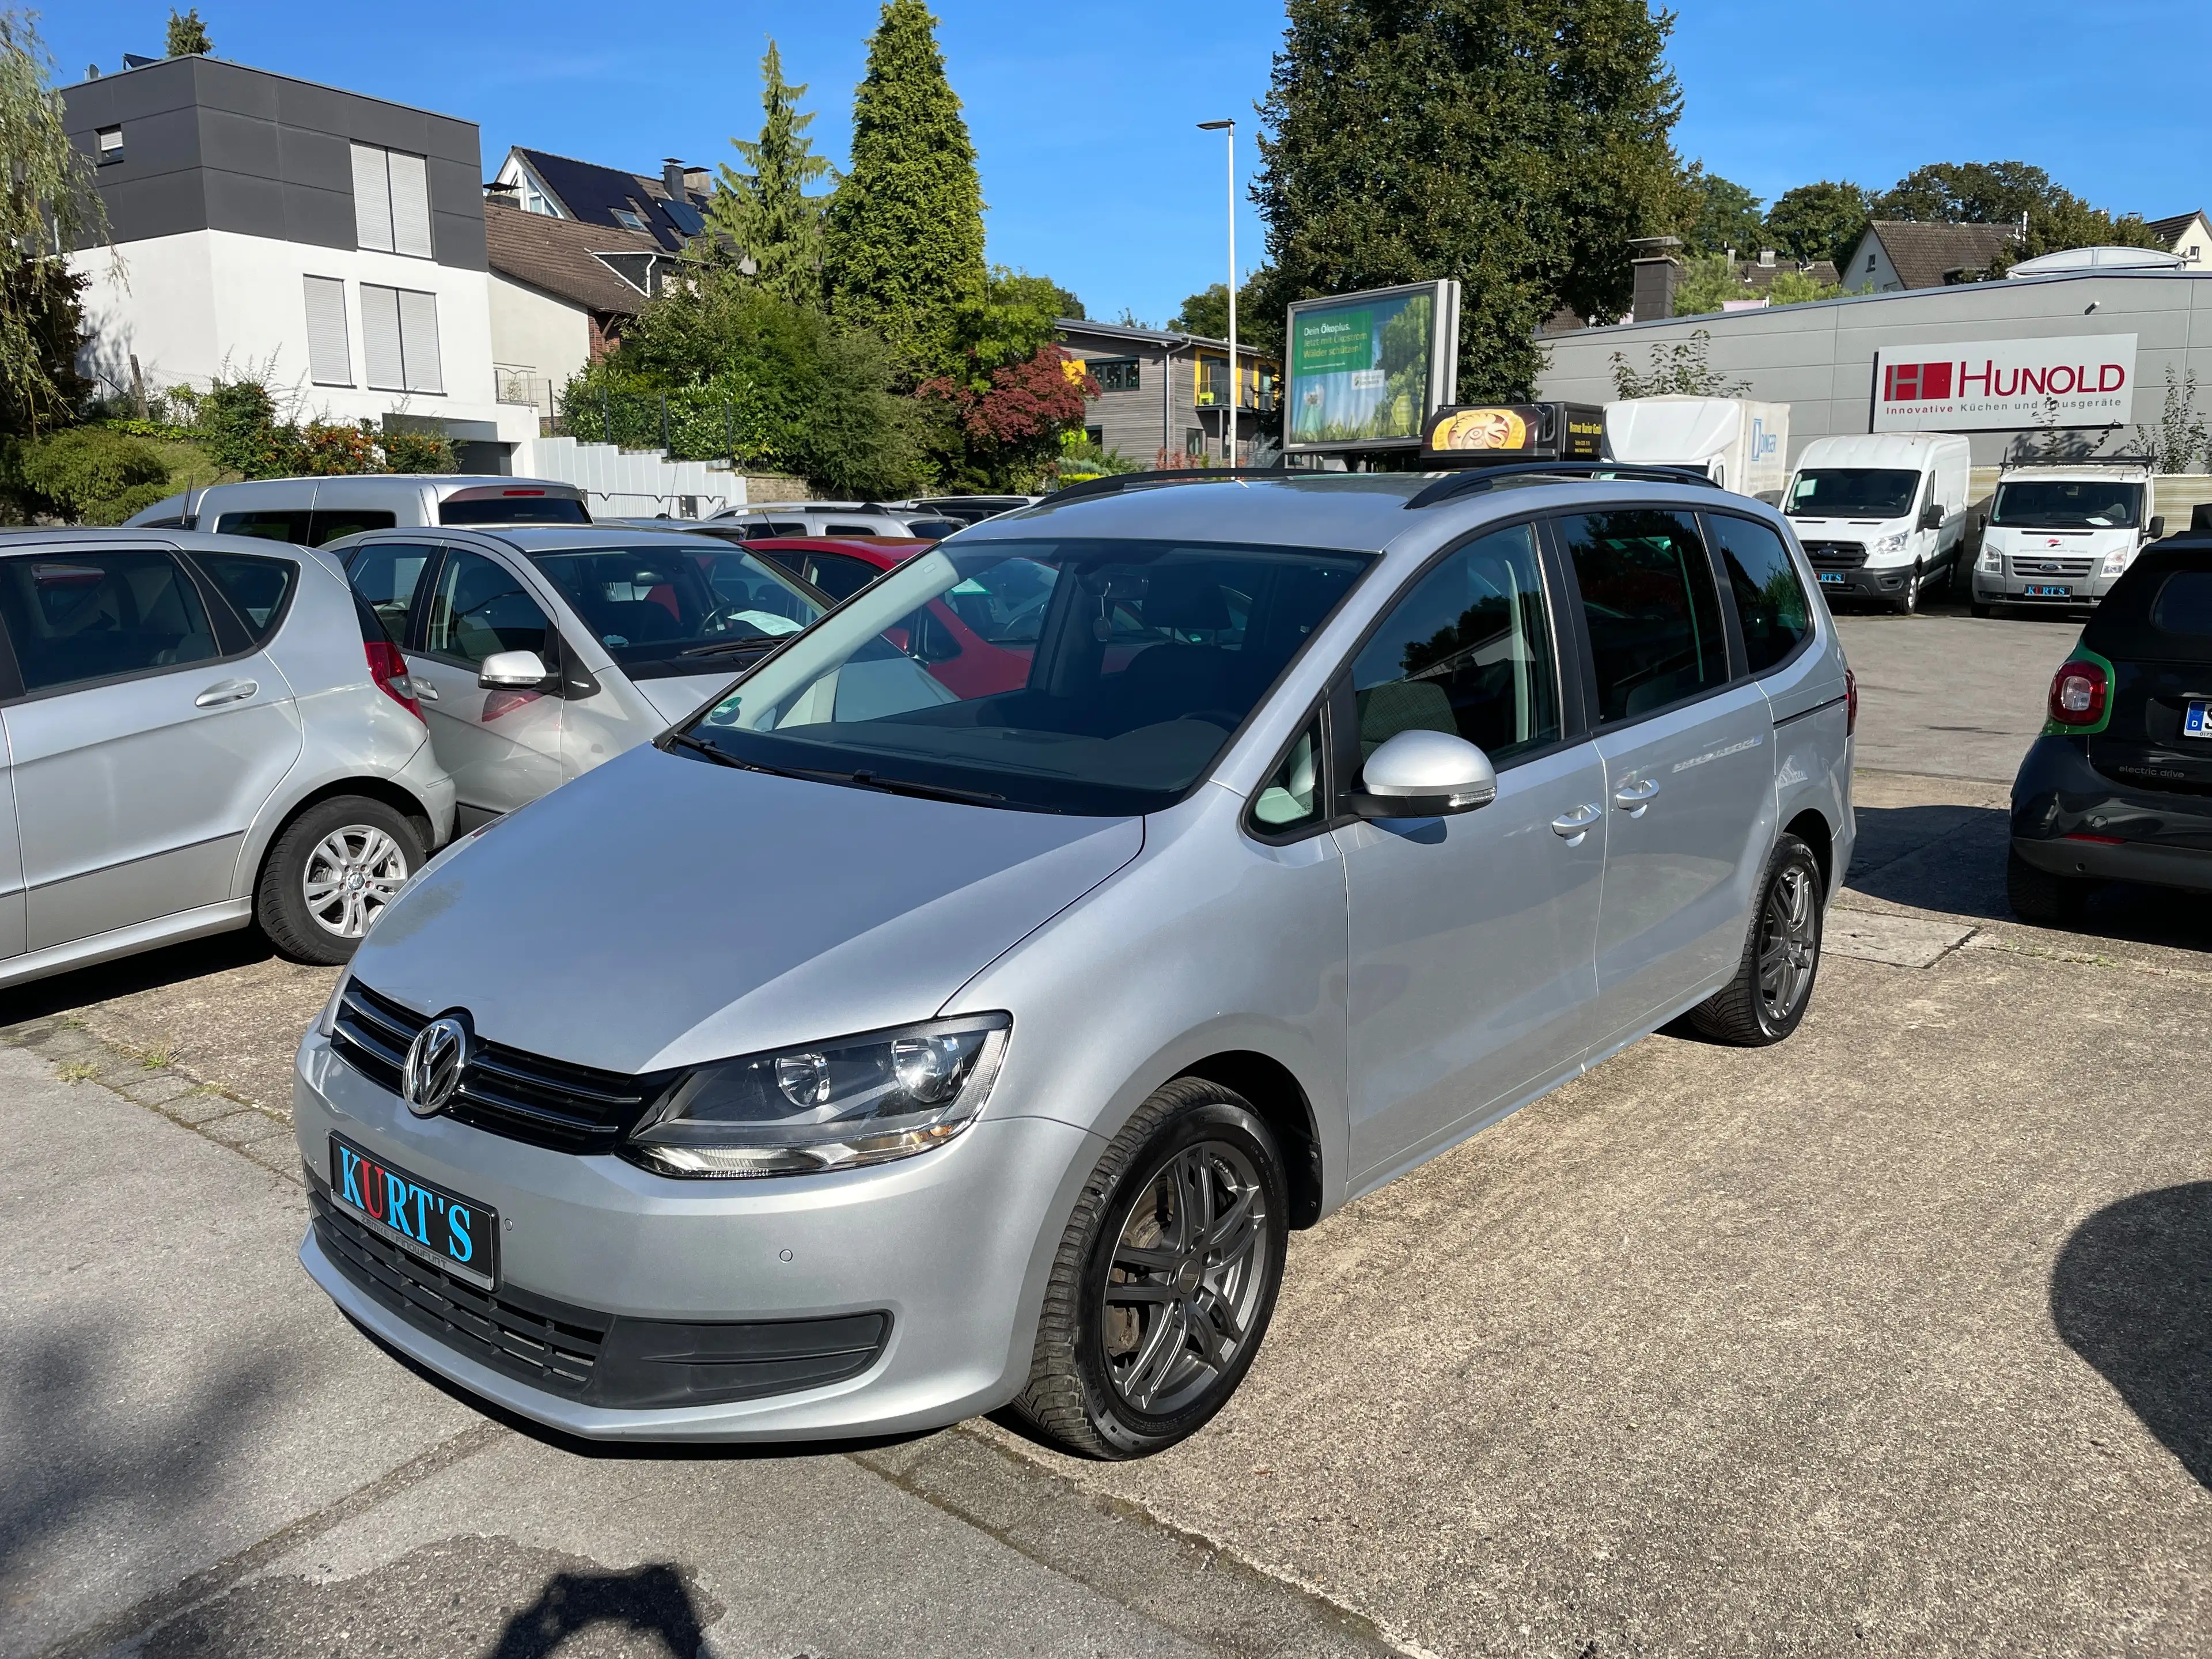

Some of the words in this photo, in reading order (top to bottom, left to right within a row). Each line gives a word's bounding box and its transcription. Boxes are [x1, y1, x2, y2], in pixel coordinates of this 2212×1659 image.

[1304, 327, 1319, 336] Dein
[1320, 323, 1351, 334] Ökoplus.
[1959, 359, 2125, 397] HUNOLD
[1887, 404, 1953, 414] Innovative
[1960, 403, 2008, 412] Küchen
[2015, 400, 2037, 410] und
[2028, 586, 2065, 594] KURT'S
[2119, 766, 2157, 775] electric
[2160, 769, 2184, 778] drive
[340, 1146, 472, 1262] KURT'S
